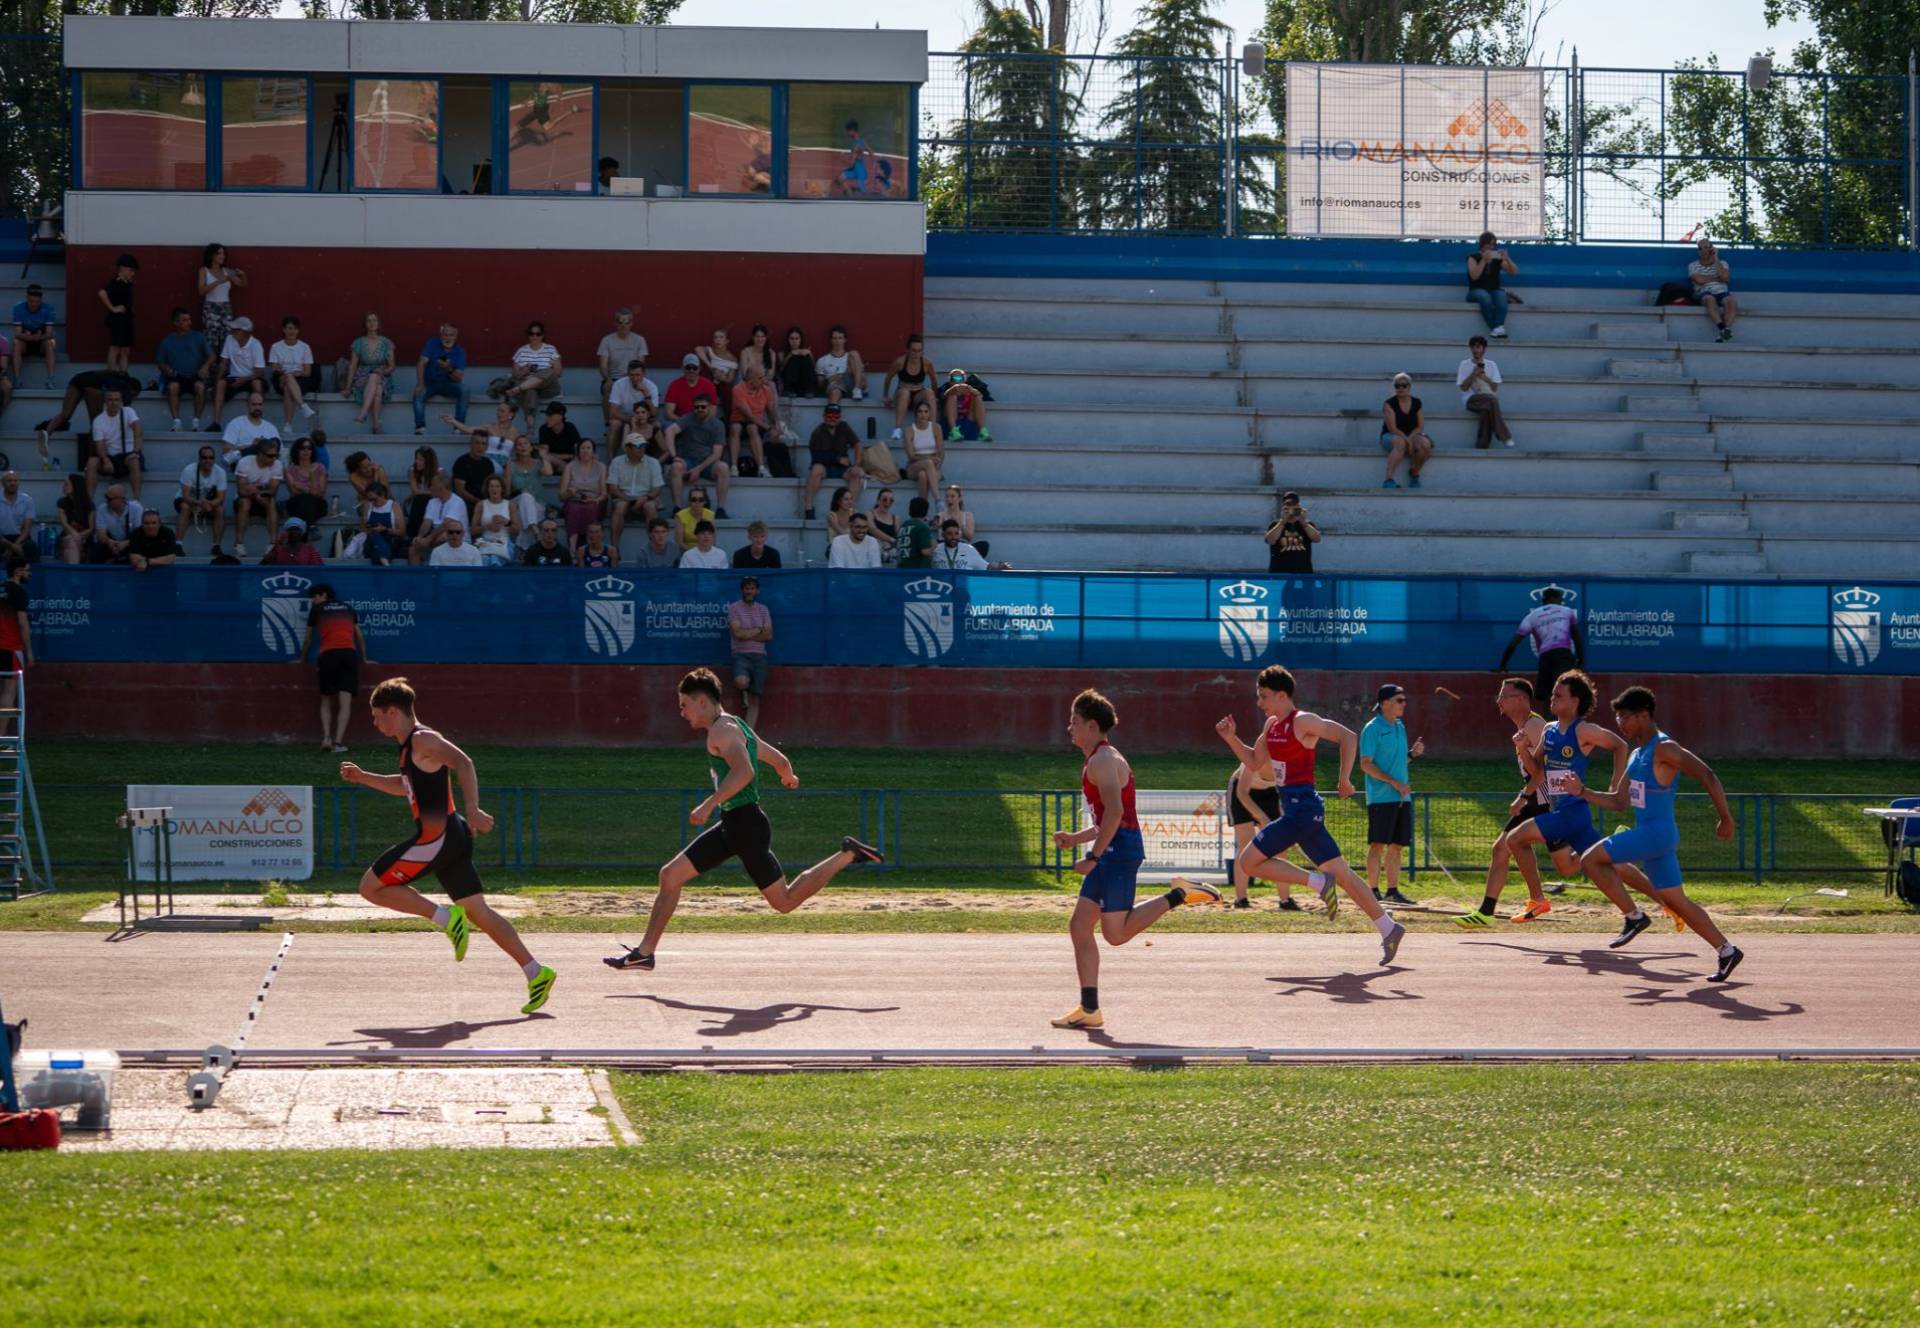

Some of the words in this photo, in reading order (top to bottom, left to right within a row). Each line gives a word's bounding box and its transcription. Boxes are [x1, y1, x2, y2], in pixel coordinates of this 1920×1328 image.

[1300, 140, 1531, 164] RIOMANAUCO
[1401, 170, 1530, 184] CONSTRUCCIONES
[1300, 196, 1421, 209] info@riomanauco.es
[1459, 200, 1480, 210] 912
[1501, 201, 1514, 210] 12
[1517, 201, 1530, 211] 65
[75, 597, 91, 609] de
[401, 598, 415, 611] de
[646, 600, 719, 615] Ayuntamiento
[964, 602, 1037, 616] Ayuntamiento
[1040, 604, 1055, 616] de
[1279, 606, 1350, 620] Ayuntamiento
[1353, 606, 1367, 619] de
[1587, 608, 1659, 623] Ayuntamiento
[1661, 609, 1675, 622] de
[646, 616, 730, 629] FUENLABRAD
[964, 618, 1054, 632] FUENLABRADA
[1279, 621, 1367, 635] FUENLABRADA
[1588, 623, 1675, 638] FUENLABRADA
[210, 839, 303, 849] CONSTRUCCIONES
